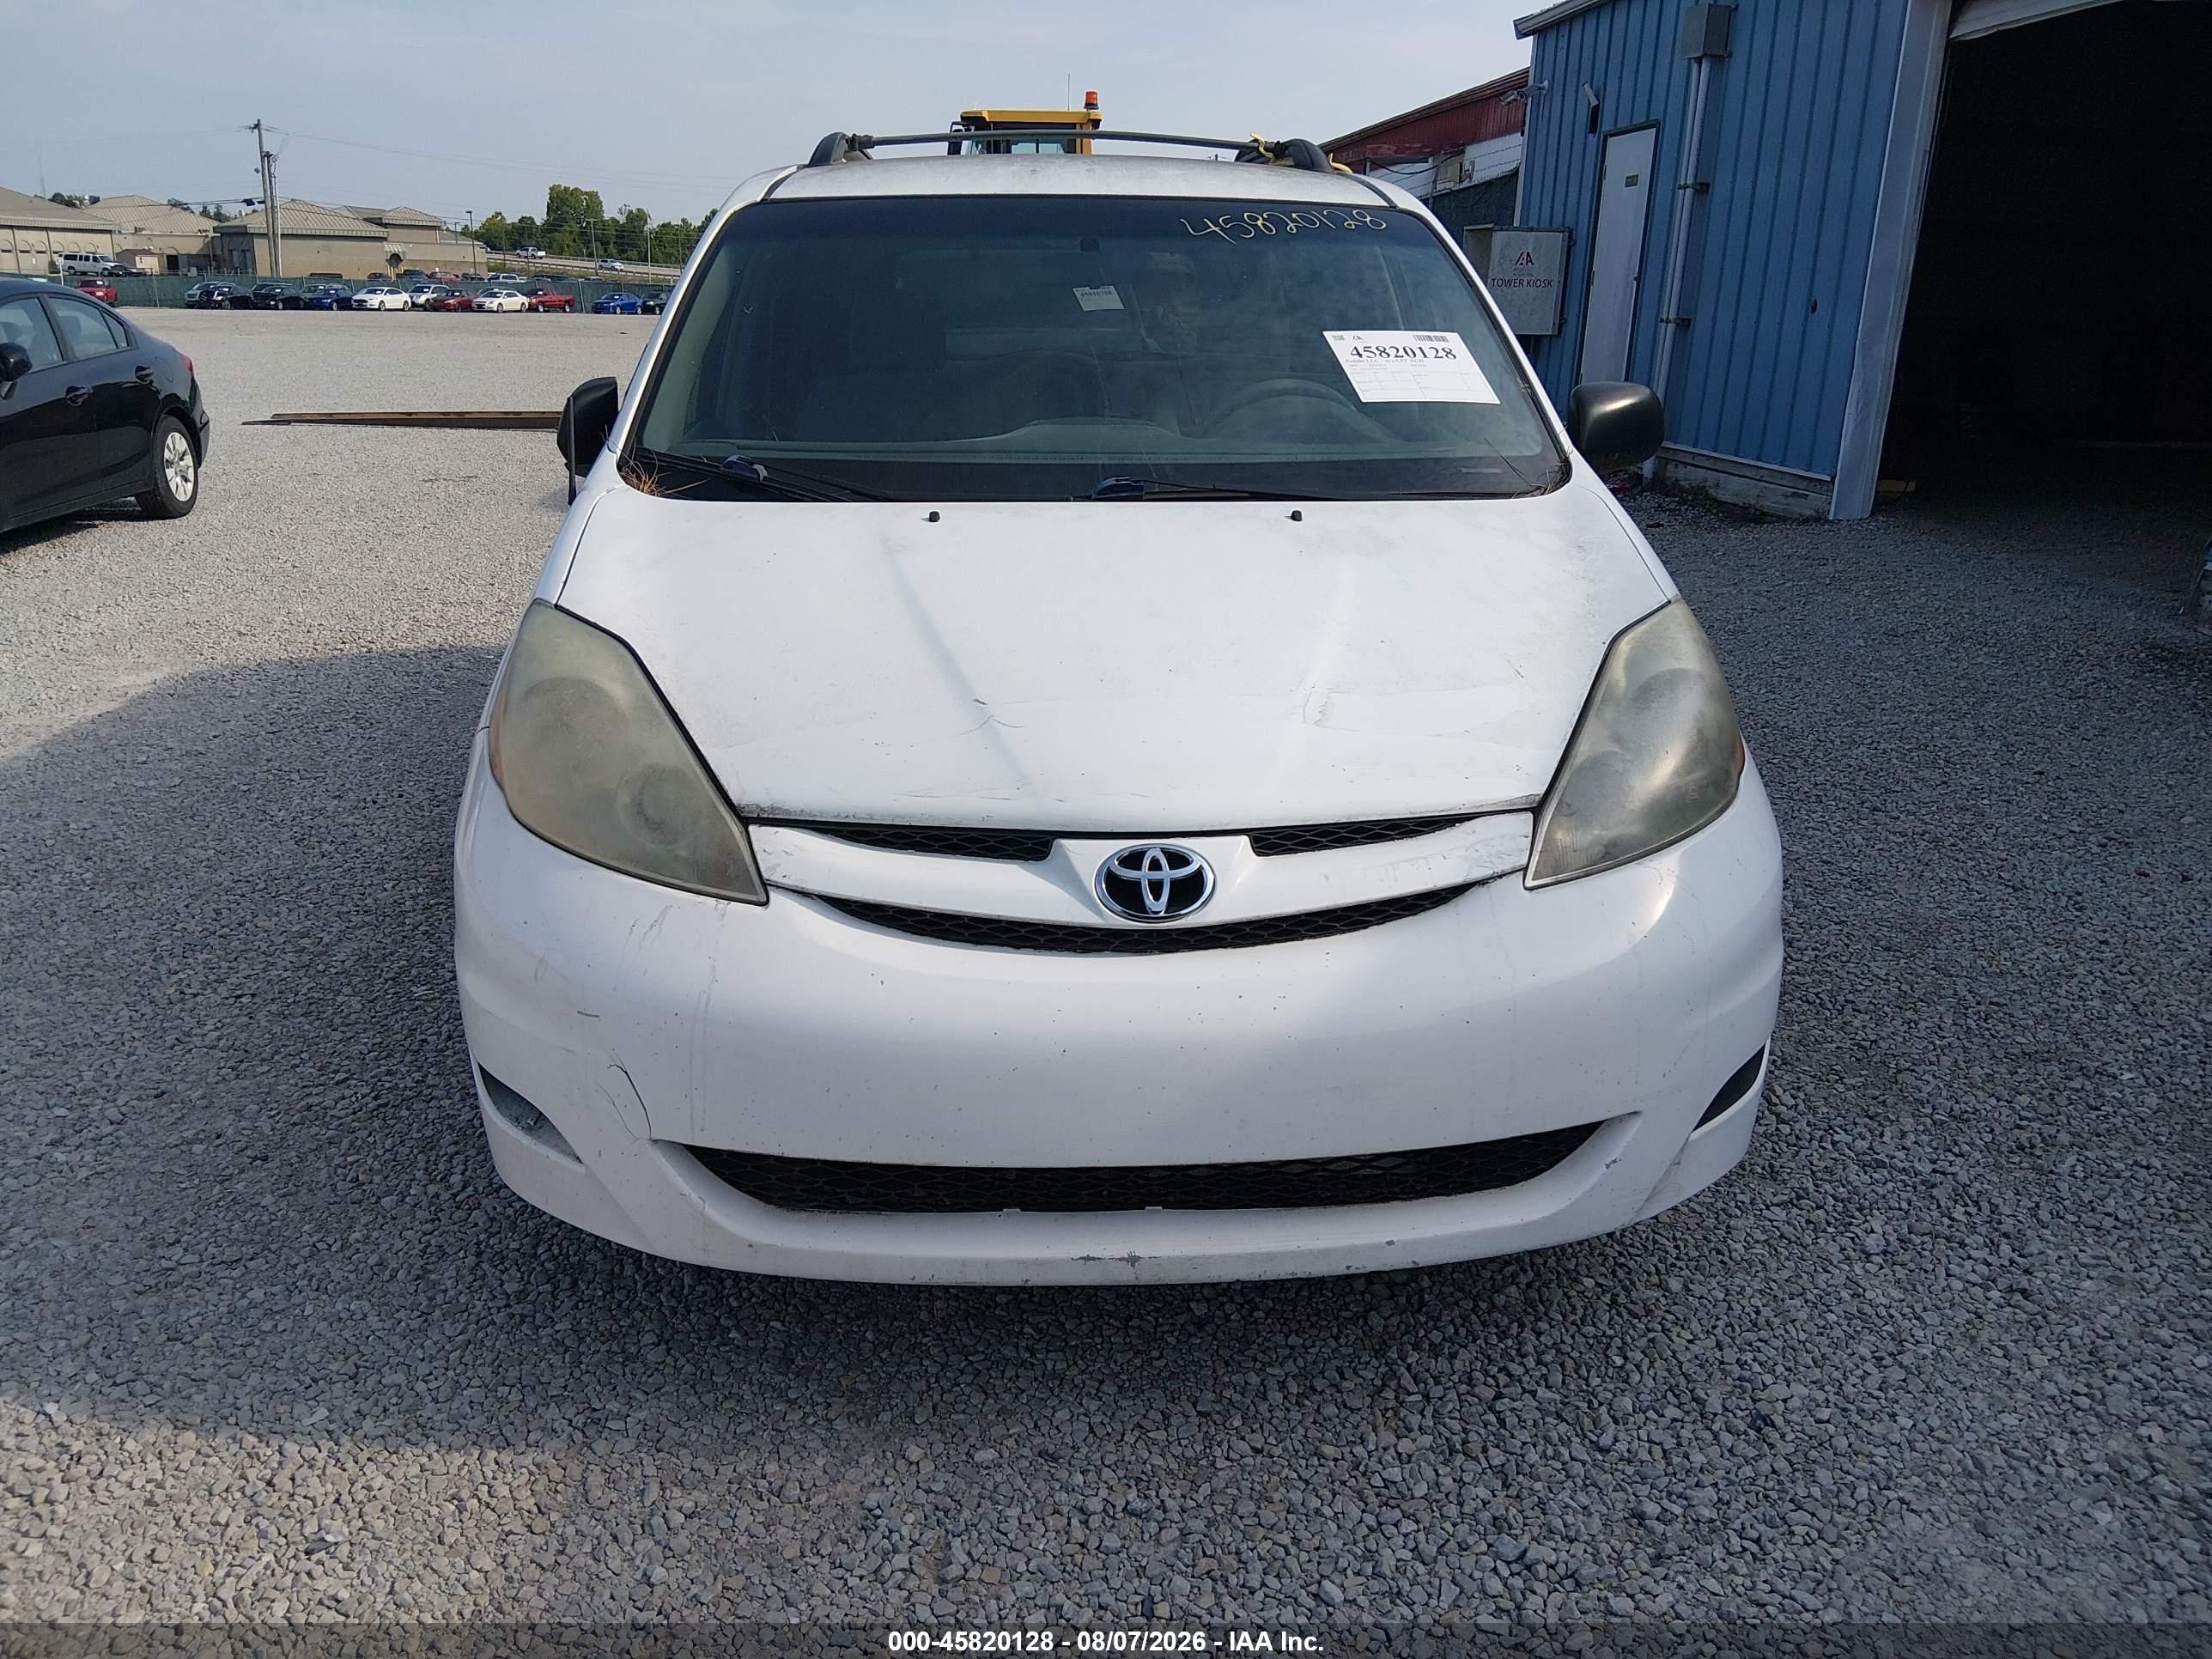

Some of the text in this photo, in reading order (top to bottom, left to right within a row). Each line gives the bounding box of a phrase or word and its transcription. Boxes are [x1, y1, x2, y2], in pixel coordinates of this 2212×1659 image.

[1180, 209, 1387, 245] 45820128
[1492, 277, 1553, 289] TOWER KIOSK
[1350, 345, 1457, 360] 45820128
